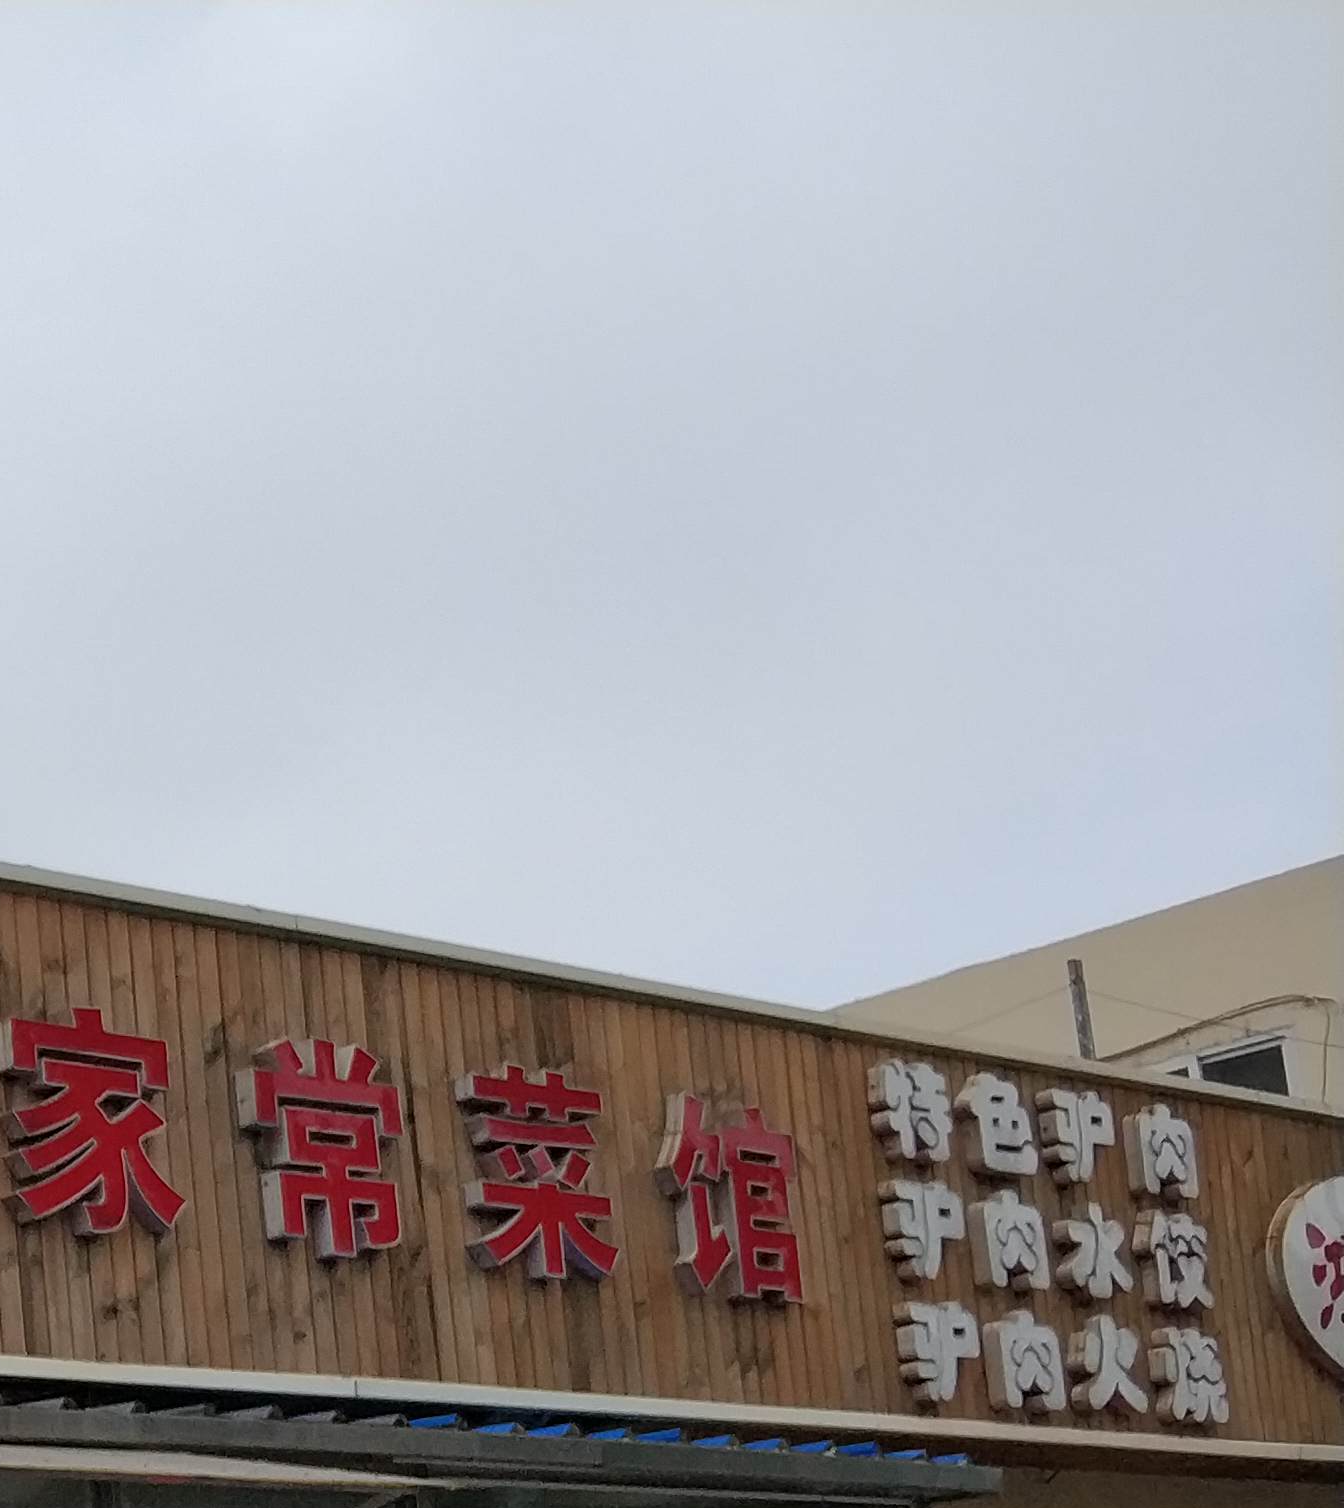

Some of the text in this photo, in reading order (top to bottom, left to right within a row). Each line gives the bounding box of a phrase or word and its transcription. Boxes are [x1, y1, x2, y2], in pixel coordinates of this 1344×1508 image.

[868, 1057, 1200, 1200] 特色驴肉
[878, 1179, 1214, 1311] 驴肉水饺
[892, 1301, 1230, 1425] 驴肉火烧
